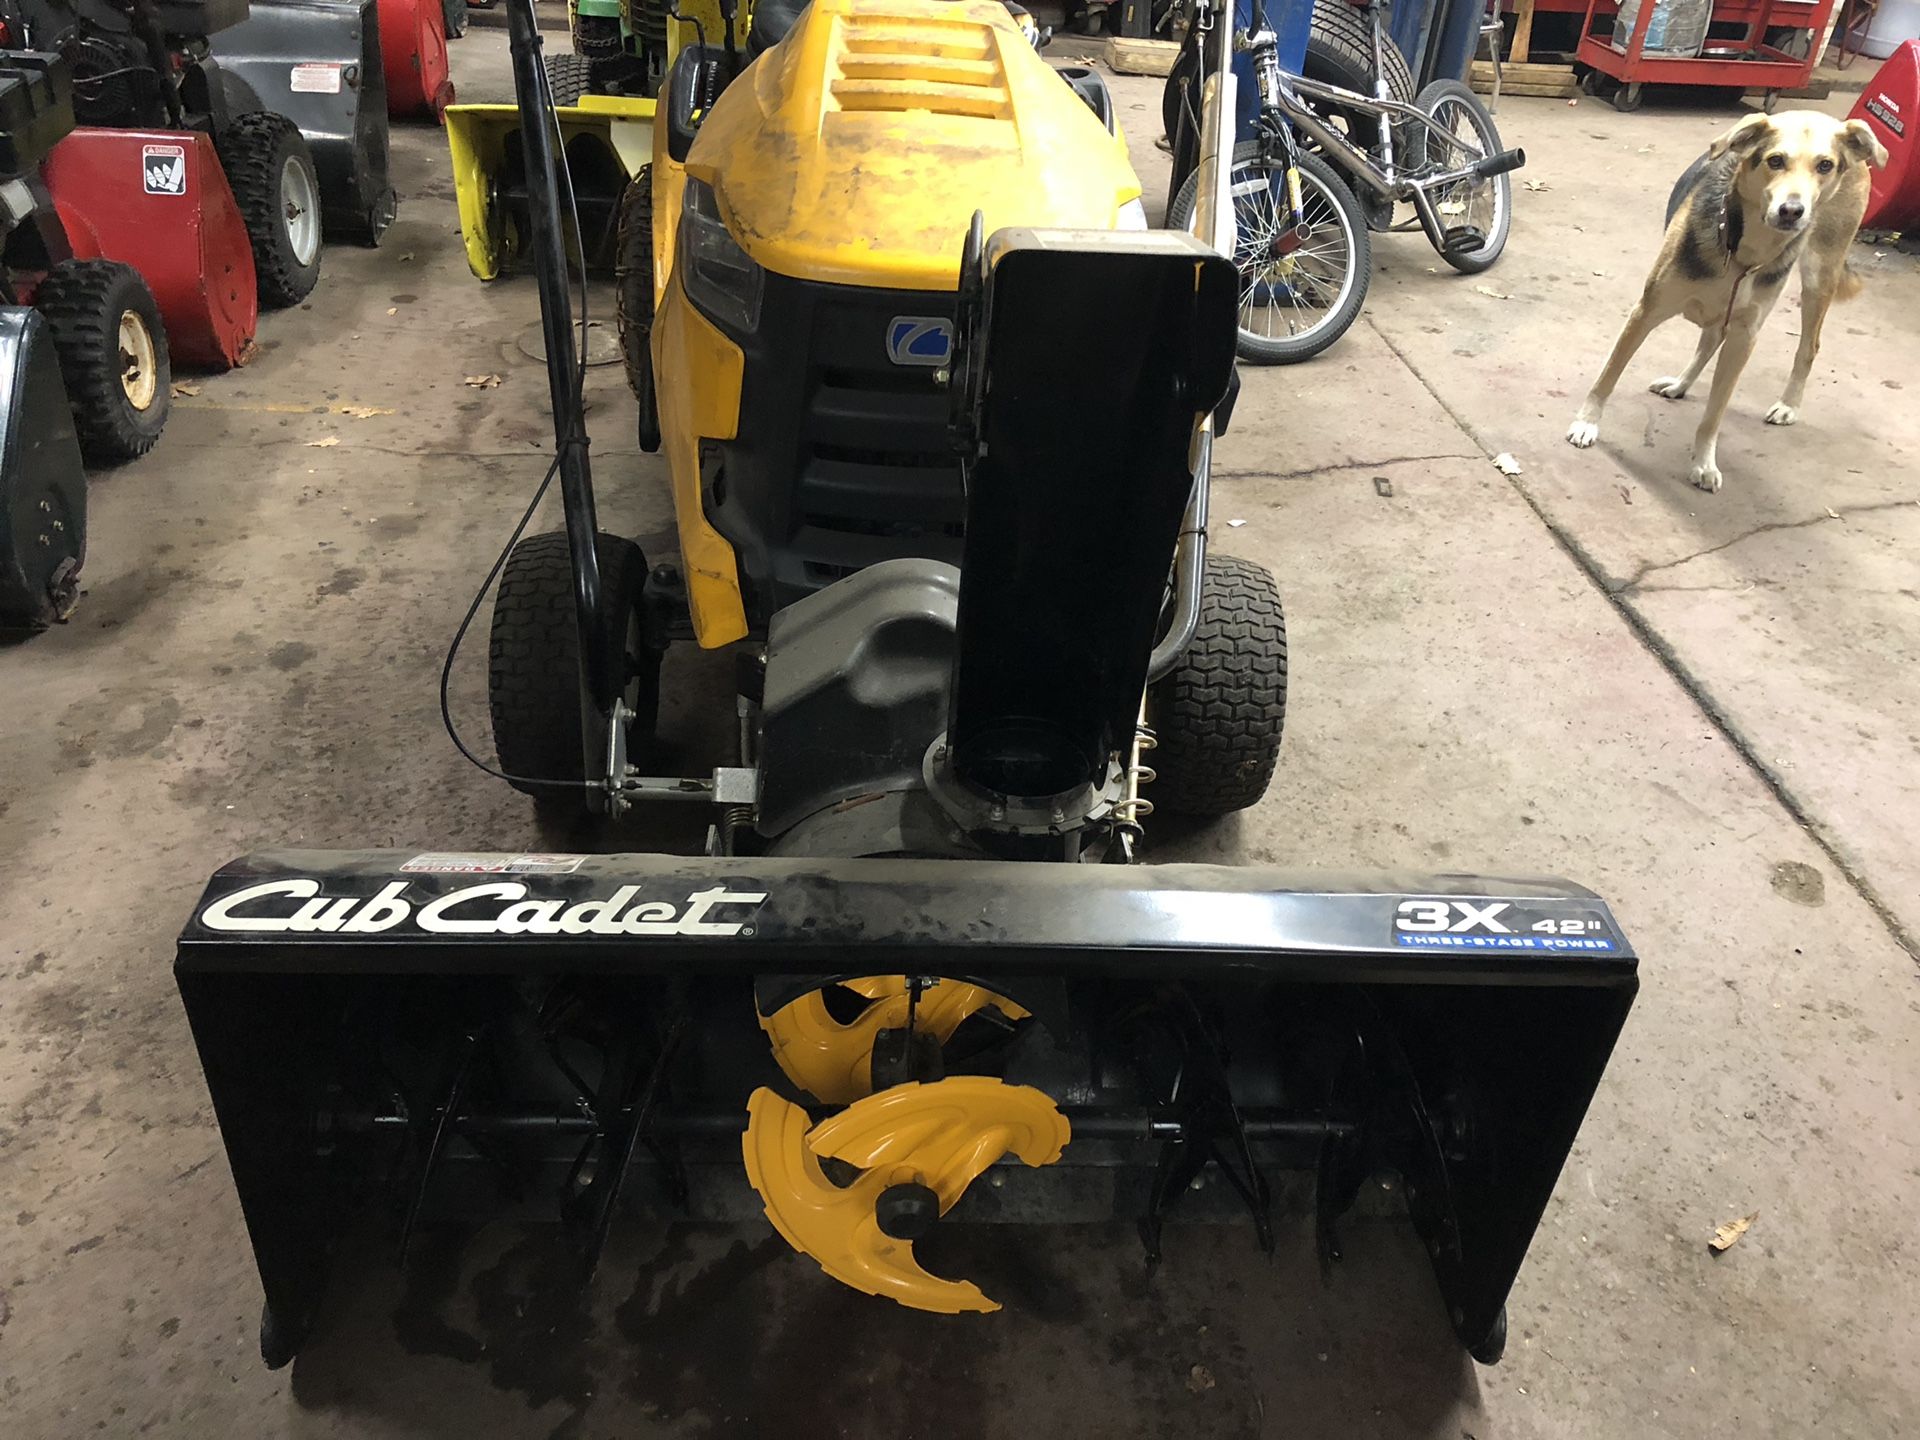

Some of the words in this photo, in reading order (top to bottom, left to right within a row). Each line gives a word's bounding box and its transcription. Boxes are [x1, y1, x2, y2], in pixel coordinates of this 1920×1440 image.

[1879, 93, 1899, 113] HONDA
[201, 879, 411, 934] Cub
[415, 882, 768, 935] Cadet
[1531, 919, 1601, 935] 42"
[1402, 935, 1535, 947] THREE-STAGE
[1543, 939, 1609, 949] POWER
